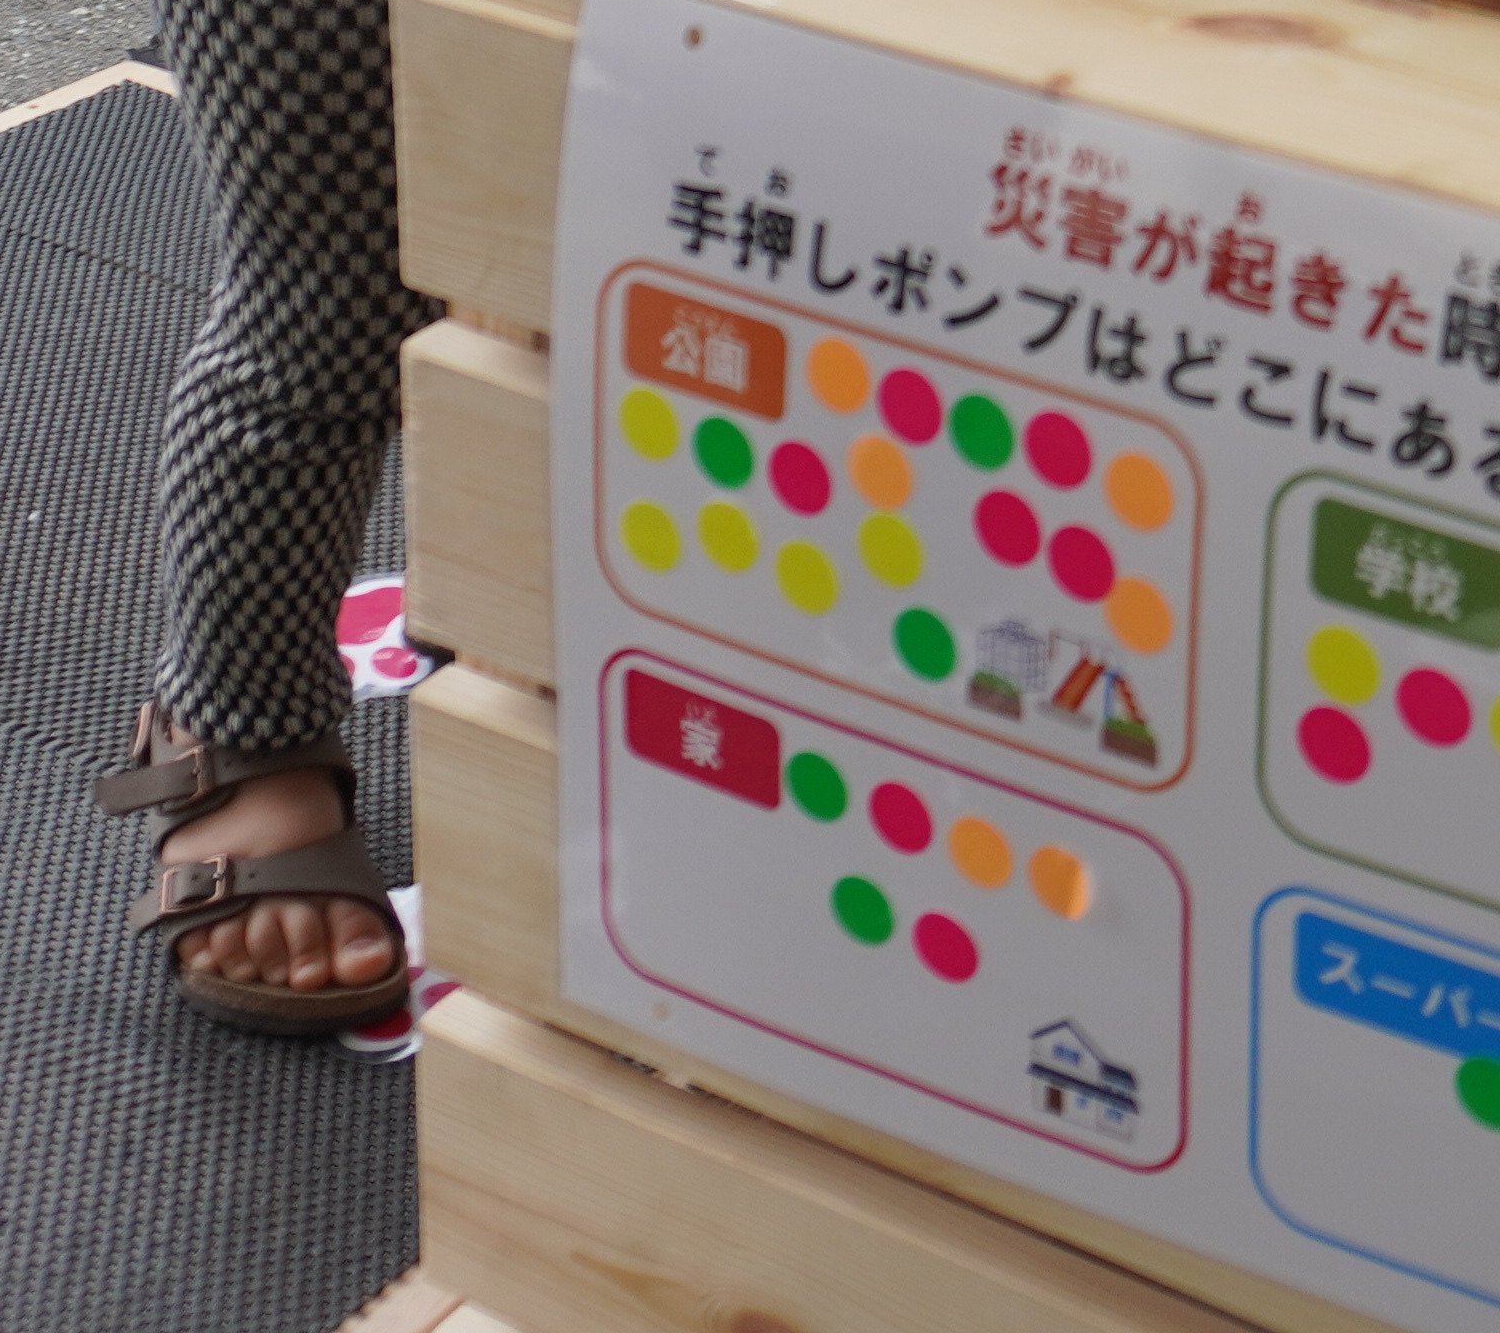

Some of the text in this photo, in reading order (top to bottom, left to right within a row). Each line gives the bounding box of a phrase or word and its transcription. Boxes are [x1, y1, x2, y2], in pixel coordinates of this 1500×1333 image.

[660, 323, 750, 395] 公園
[1354, 543, 1462, 625] 学校
[679, 717, 726, 773] 家
